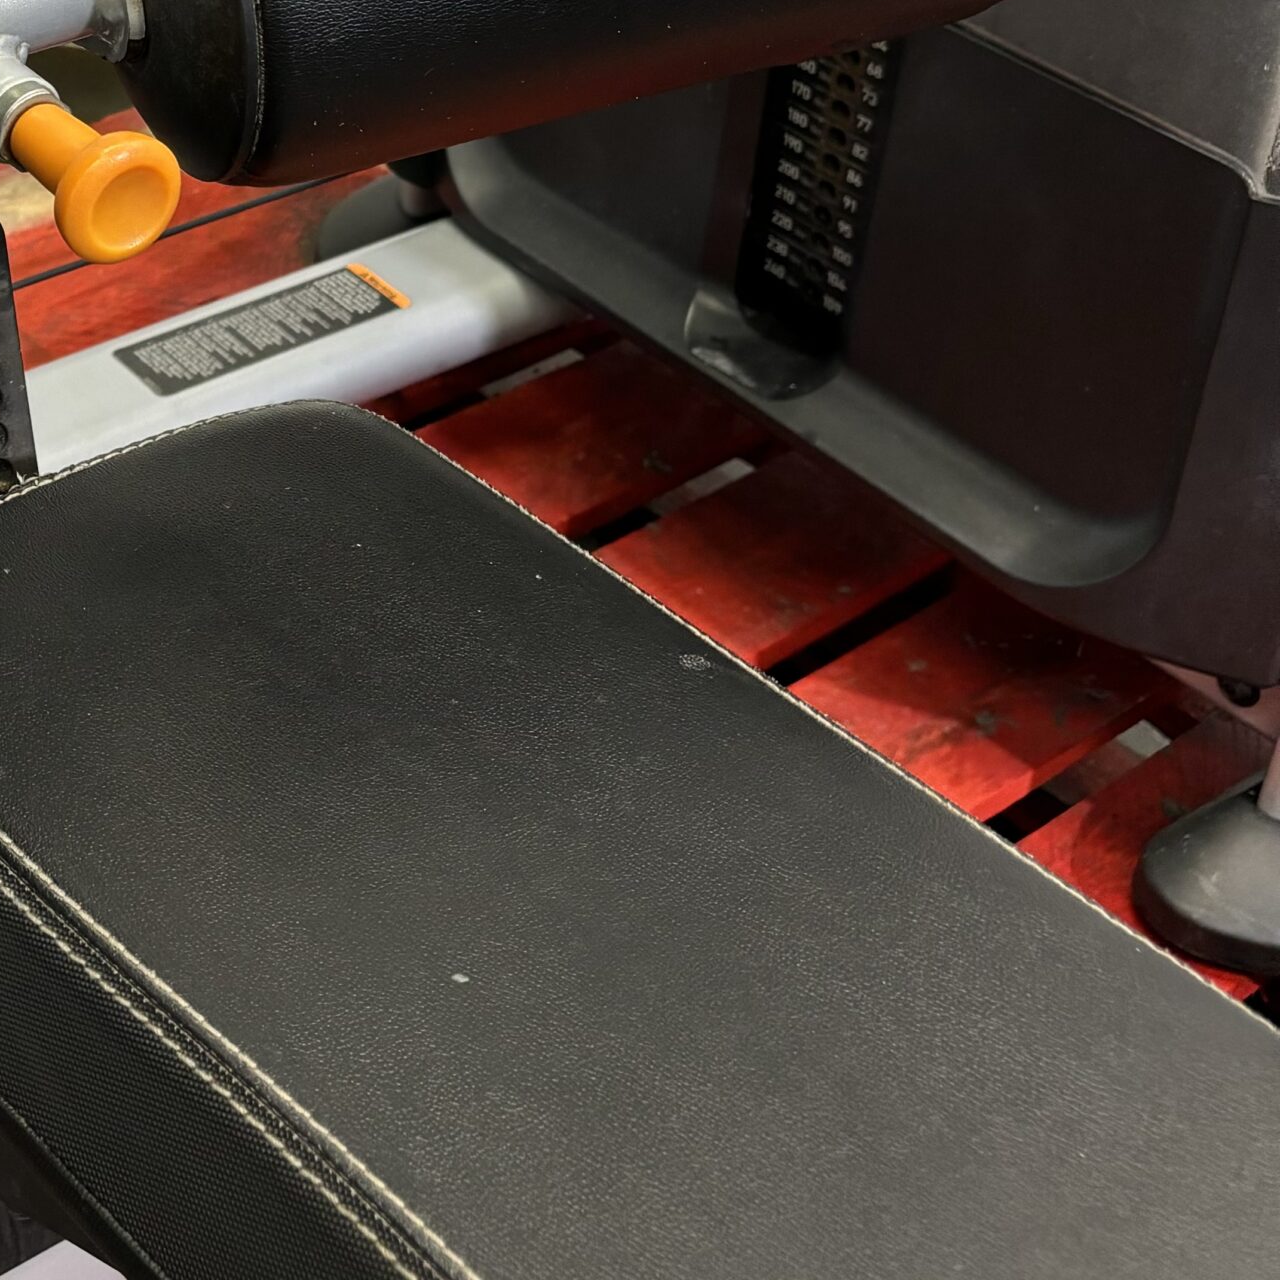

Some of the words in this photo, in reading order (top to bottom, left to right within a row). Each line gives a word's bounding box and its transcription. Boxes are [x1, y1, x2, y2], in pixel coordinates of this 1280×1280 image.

[788, 106, 809, 128] 180
[792, 79, 813, 101] 170
[856, 113, 873, 132] 77
[784, 132, 804, 154] 190
[777, 158, 800, 180] 200
[843, 195, 858, 214] 91
